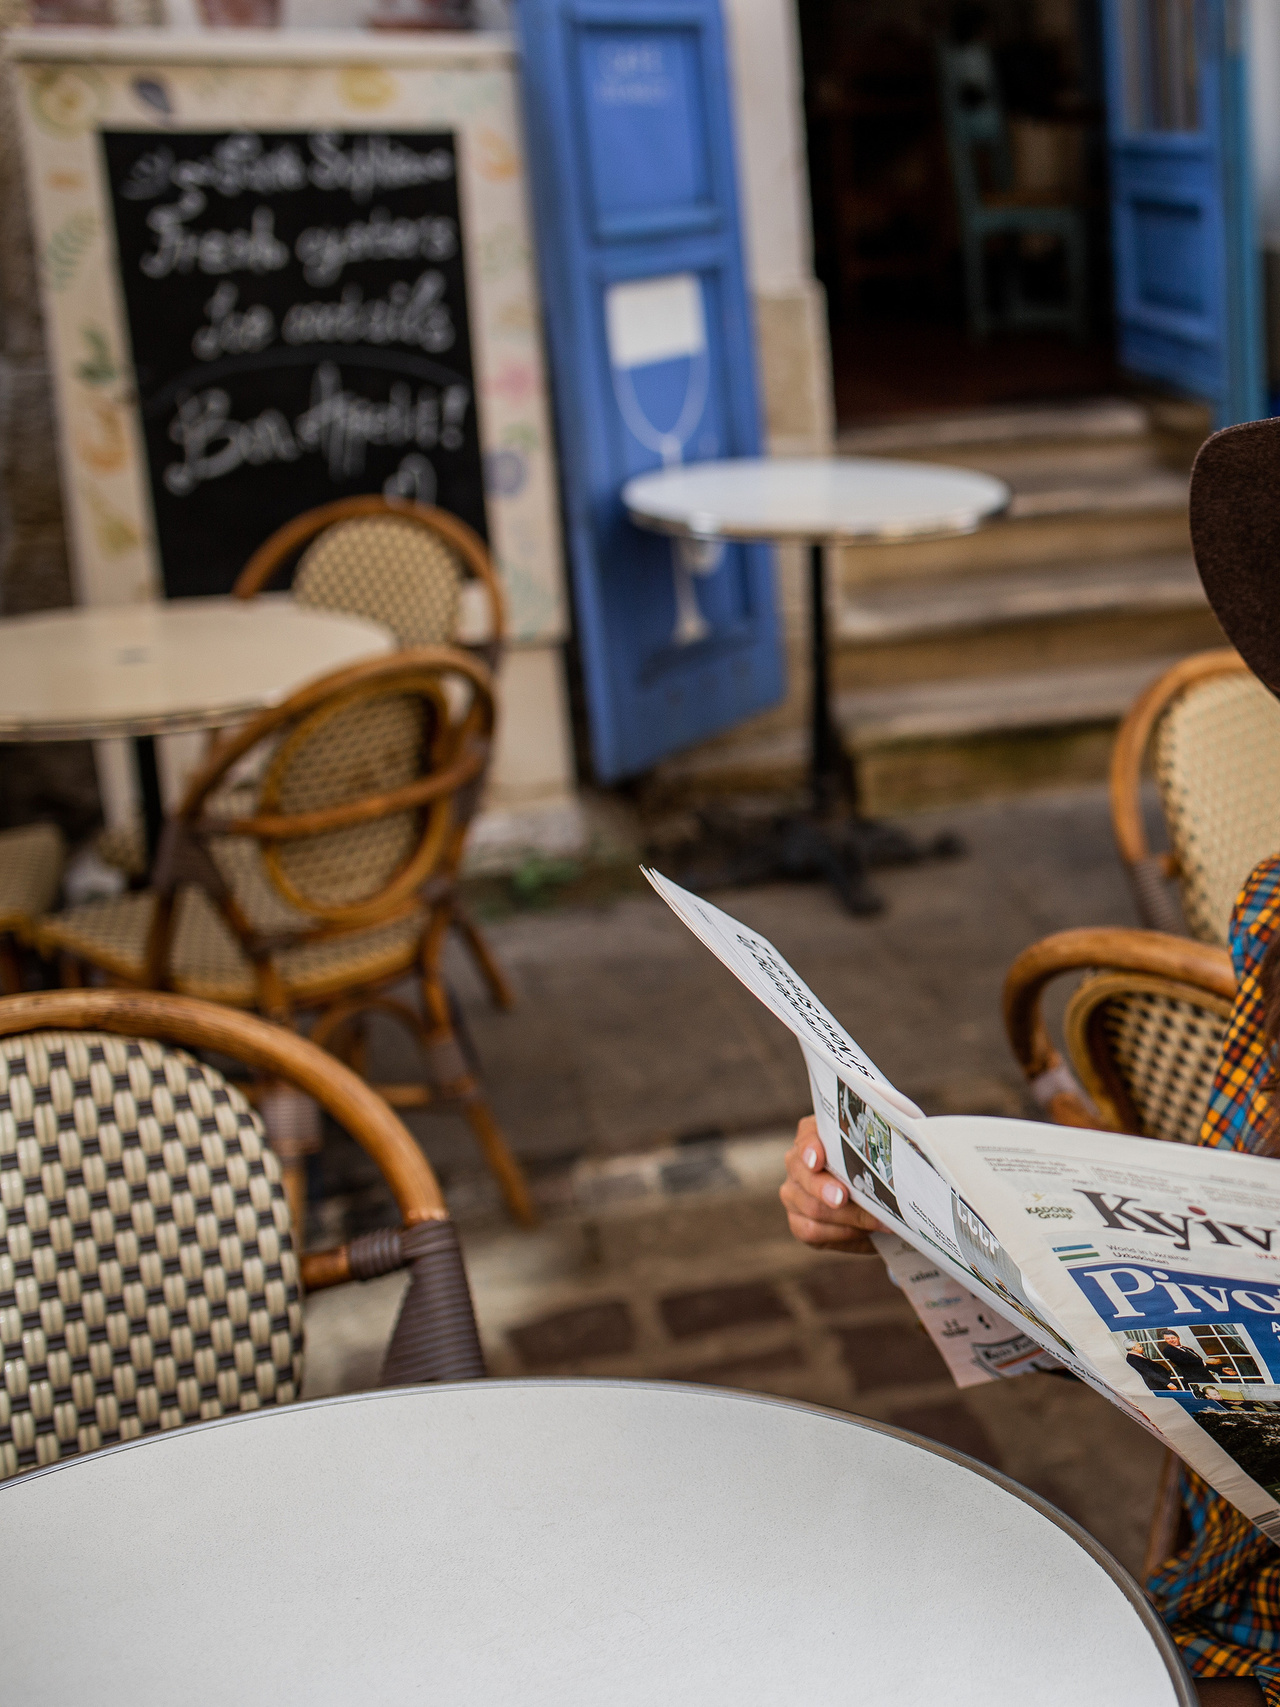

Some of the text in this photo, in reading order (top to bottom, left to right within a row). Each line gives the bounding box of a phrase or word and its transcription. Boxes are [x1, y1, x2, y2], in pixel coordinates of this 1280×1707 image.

[767, 955, 820, 1014] Stream
[809, 1011, 858, 1060] Nord
[1025, 1206, 1076, 1215] KADORR
[1038, 1212, 1073, 1220] Group
[1073, 1188, 1277, 1252] Kyiv
[1106, 1243, 1136, 1254] World
[1112, 1251, 1170, 1265] Uzbekistan
